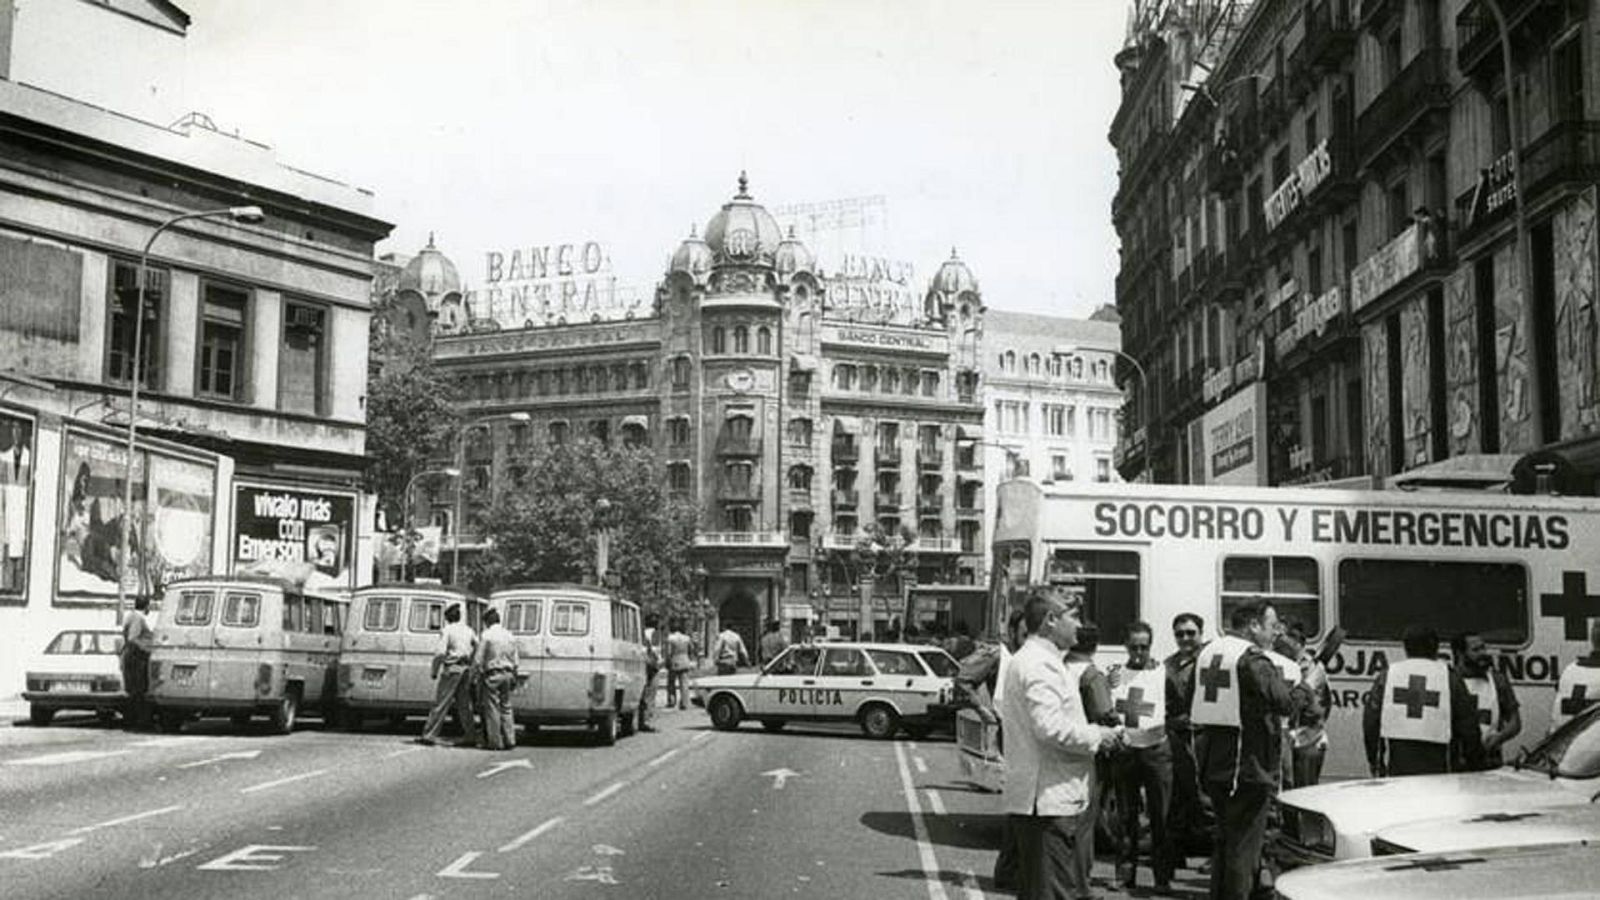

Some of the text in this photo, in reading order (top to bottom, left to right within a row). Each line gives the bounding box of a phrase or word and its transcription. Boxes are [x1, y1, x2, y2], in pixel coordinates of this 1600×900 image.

[486, 242, 601, 283] BANCO
[838, 331, 929, 349] BANCO CENTRAL
[300, 498, 331, 521] más
[279, 519, 304, 540] con
[1094, 503, 1570, 549] SOCORRO Y EMERGENCIAS
[239, 534, 304, 562] Emerson
[1324, 650, 1389, 676] OJA
[778, 688, 843, 706] POLICIA
